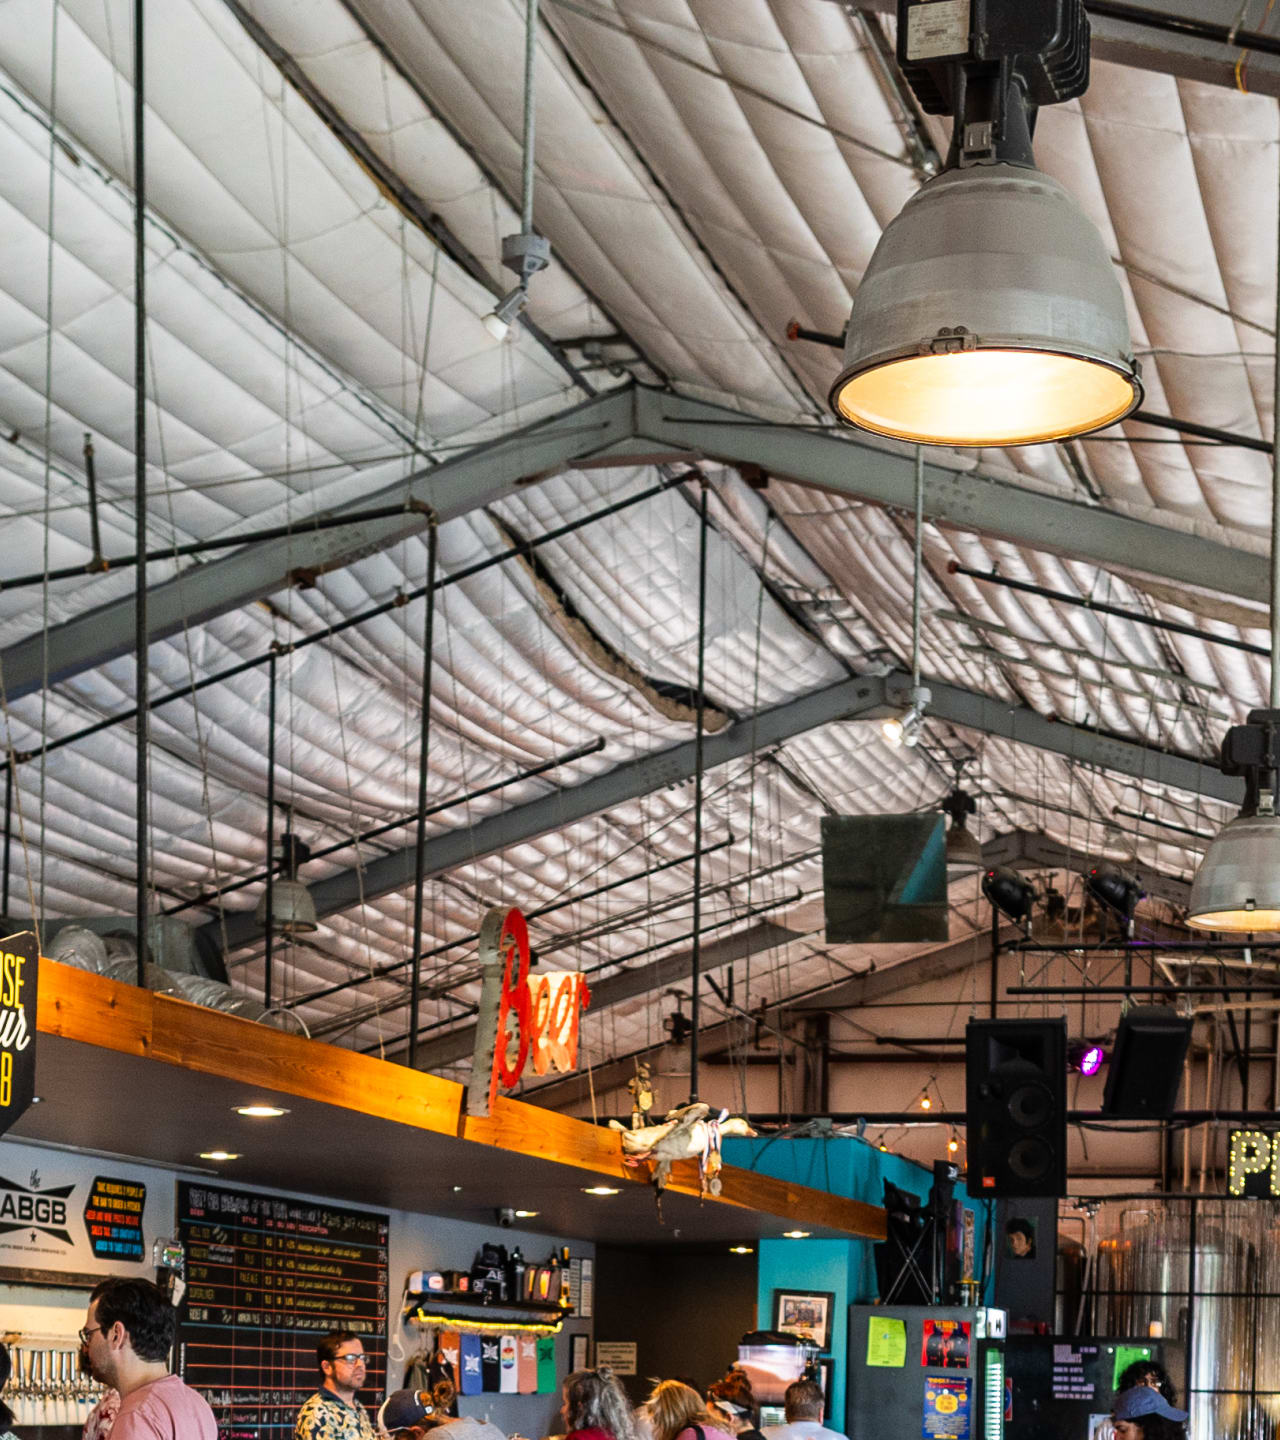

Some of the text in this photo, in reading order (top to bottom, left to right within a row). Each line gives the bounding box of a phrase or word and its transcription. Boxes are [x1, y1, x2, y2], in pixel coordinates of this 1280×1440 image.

[489, 907, 591, 1107] Beer
[30, 1168, 41, 1189] the
[0, 1193, 67, 1225] ABGB
[242, 1215, 258, 1225] STYLE
